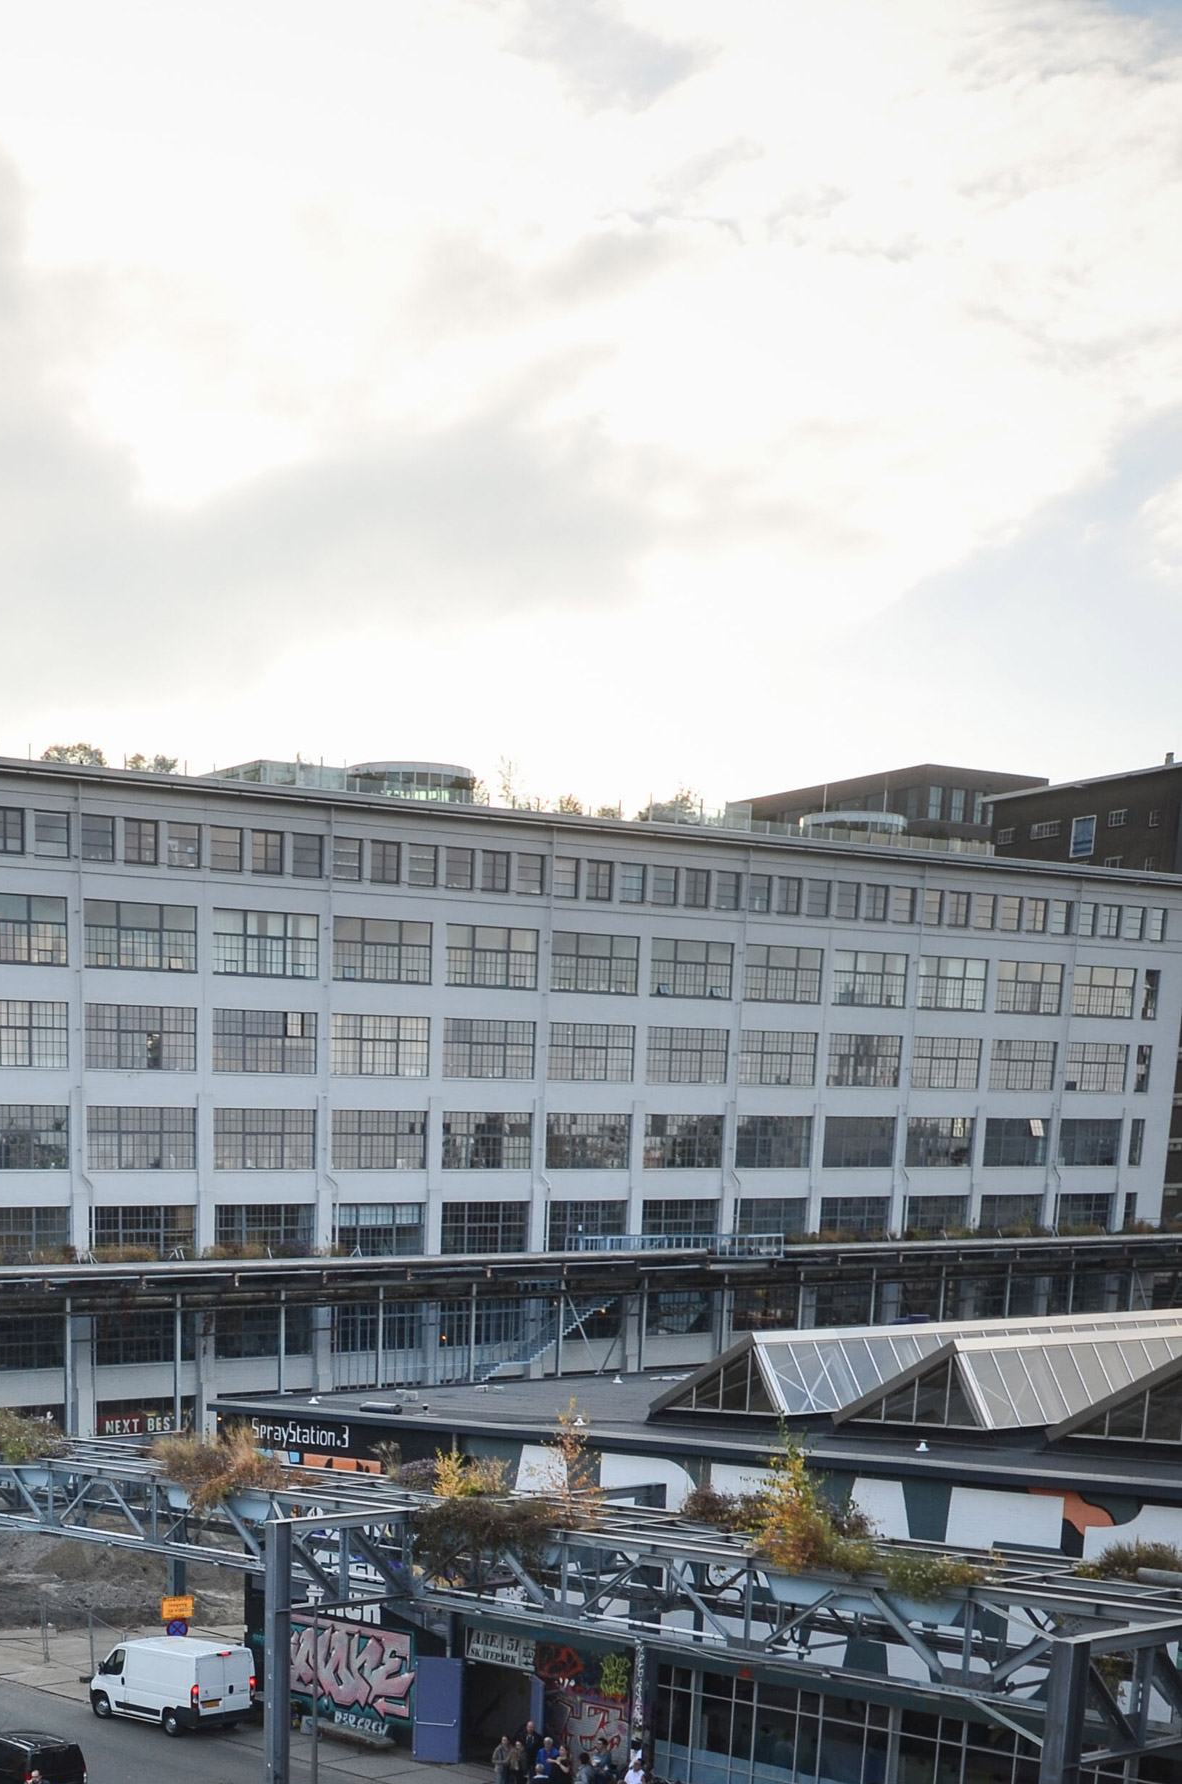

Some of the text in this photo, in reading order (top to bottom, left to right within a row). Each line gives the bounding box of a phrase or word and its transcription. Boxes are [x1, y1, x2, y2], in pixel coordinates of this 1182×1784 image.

[105, 1416, 175, 1434] NEXT BES
[507, 1637, 519, 1652] 51
